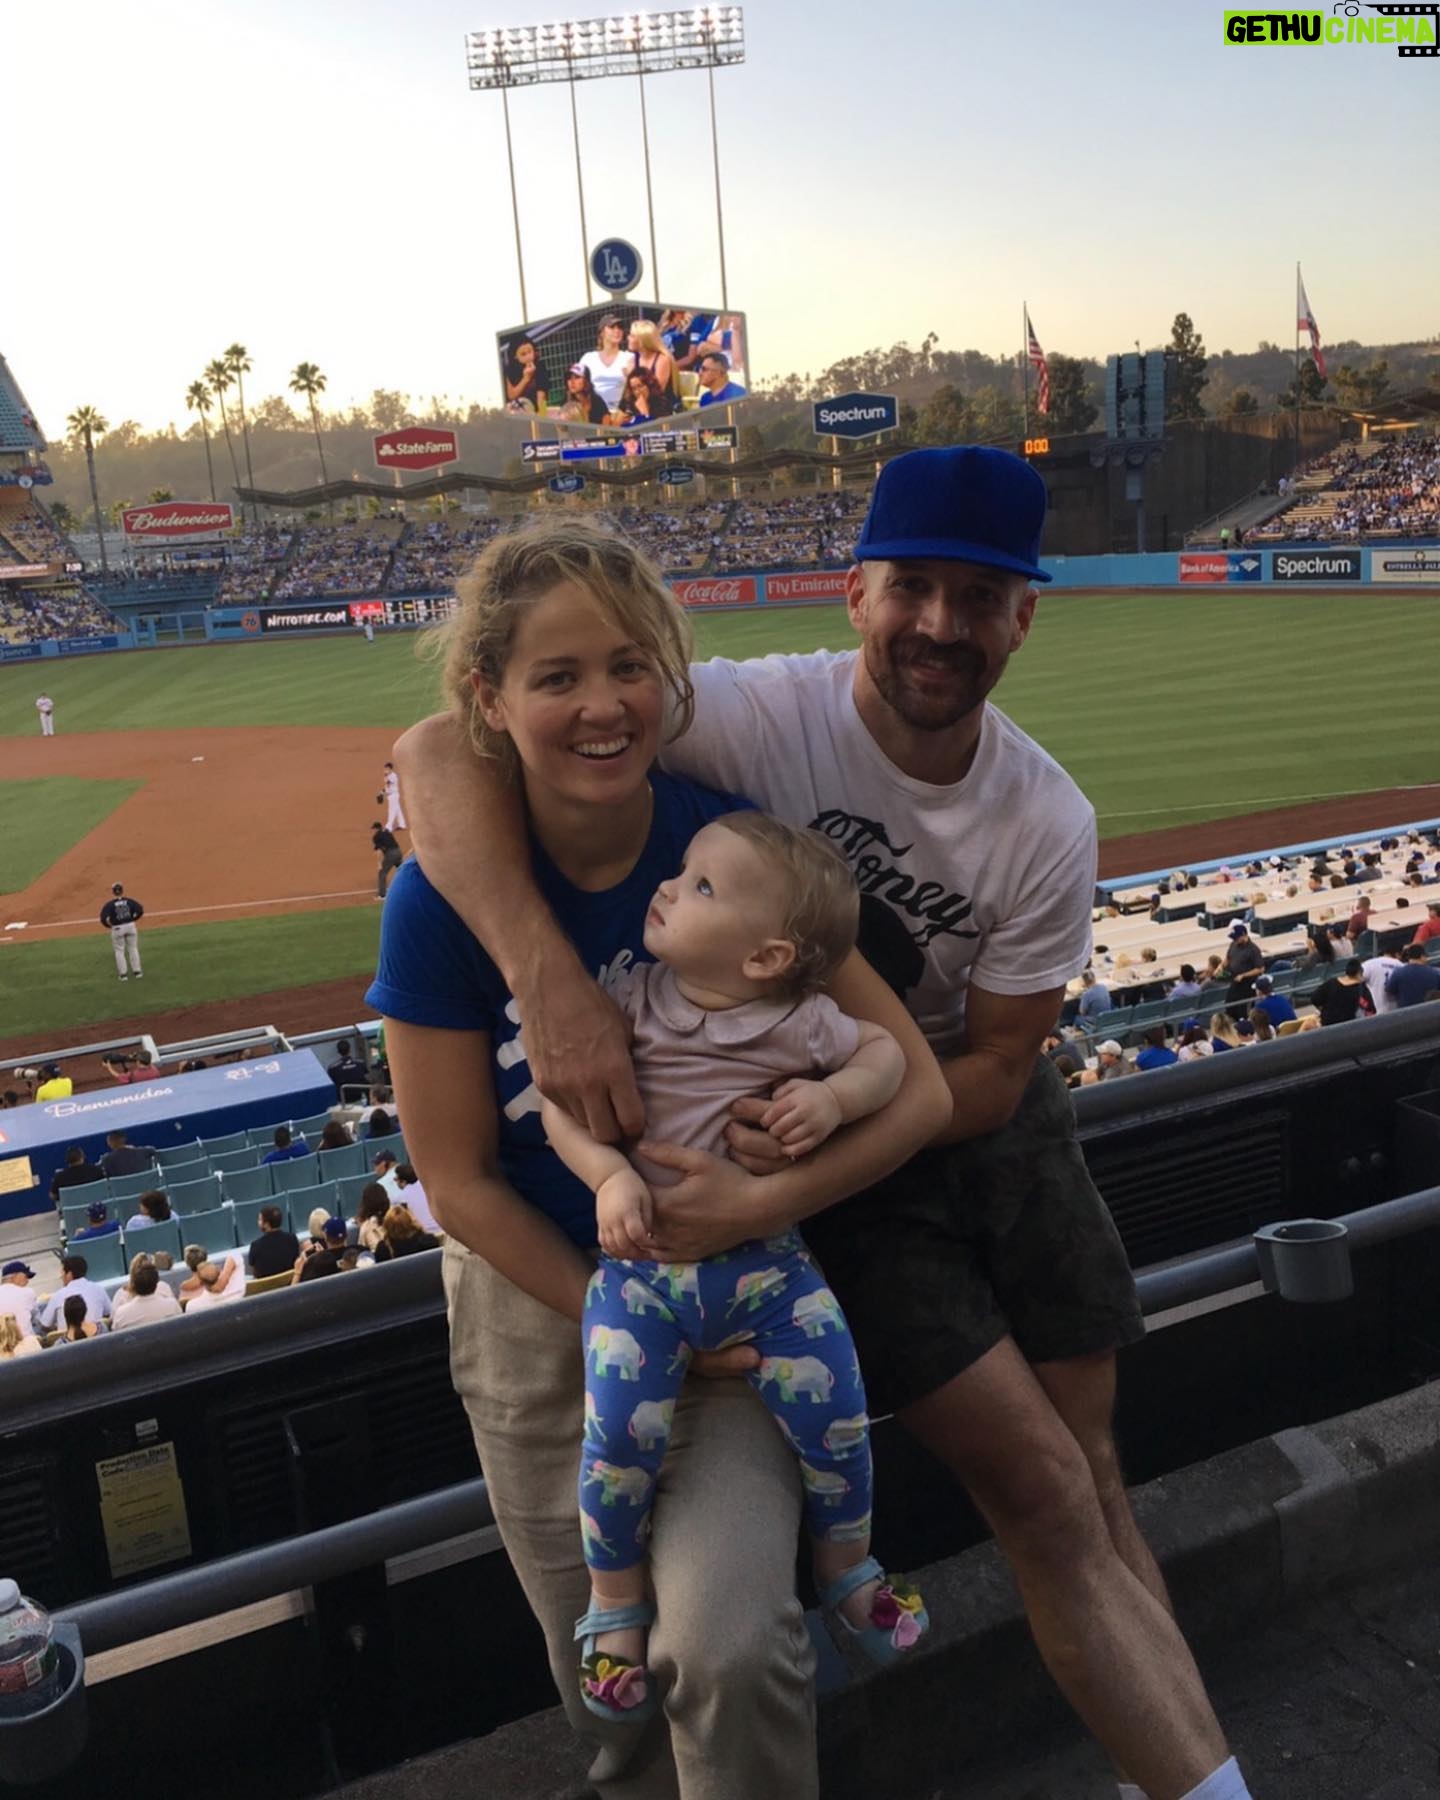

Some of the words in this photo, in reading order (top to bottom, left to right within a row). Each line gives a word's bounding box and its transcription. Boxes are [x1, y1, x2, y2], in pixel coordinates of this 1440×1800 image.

[602, 248, 628, 284] LA
[820, 407, 886, 426] Spectrum
[126, 511, 229, 530] Budweiser
[1208, 563, 1240, 574] America
[1277, 556, 1351, 578] Spectrum
[768, 581, 790, 595] Fly
[791, 576, 847, 593] Emirates
[44, 1087, 174, 1118] Bienvenidos
